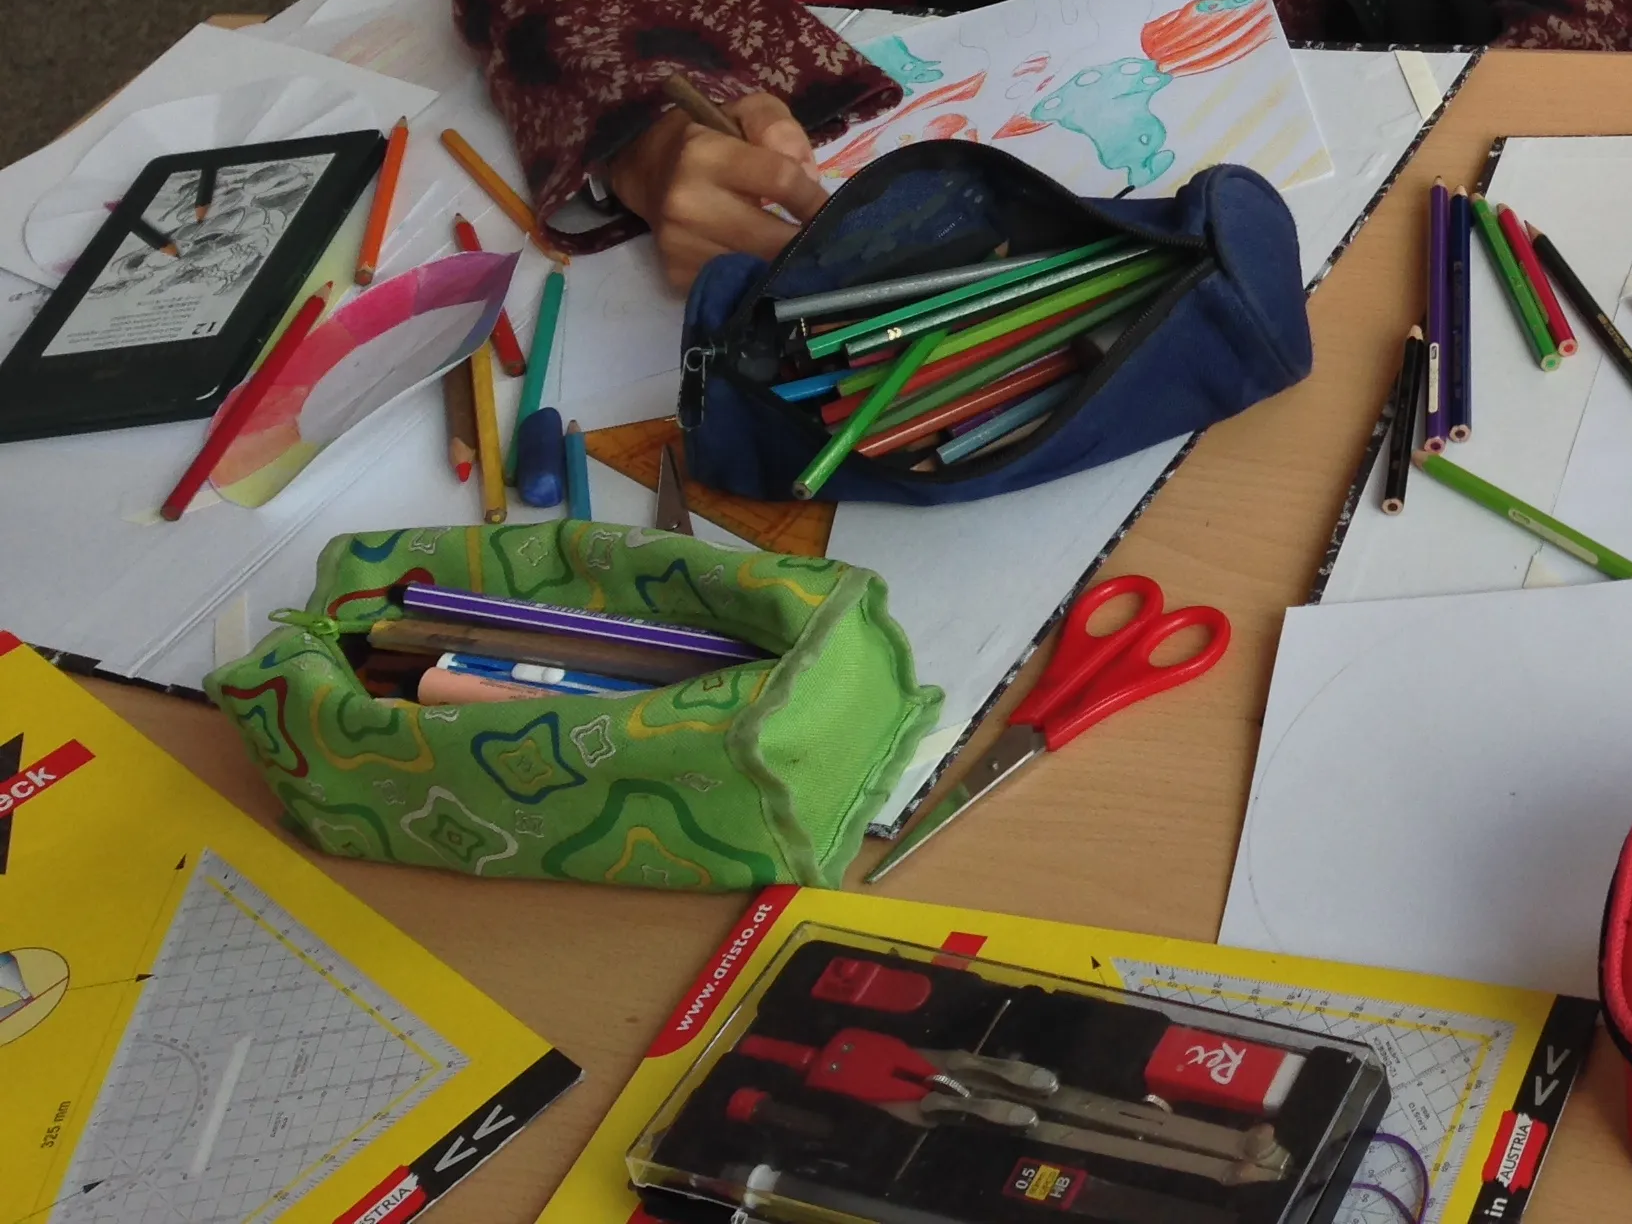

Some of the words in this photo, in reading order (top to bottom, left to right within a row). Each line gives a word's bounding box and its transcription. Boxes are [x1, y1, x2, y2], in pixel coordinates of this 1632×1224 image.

[192, 321, 217, 335] 12
[676, 903, 773, 1031] www.aristo.at
[1184, 1042, 1247, 1085] Rex
[40, 1125, 61, 1149] 325
[53, 1100, 72, 1123] mm
[1015, 1167, 1036, 1190] 0.5
[1049, 1176, 1070, 1198] HB
[1484, 1197, 1509, 1219] in
[1500, 1123, 1531, 1181] AUSTRIA
[359, 1187, 412, 1224] STRIA
